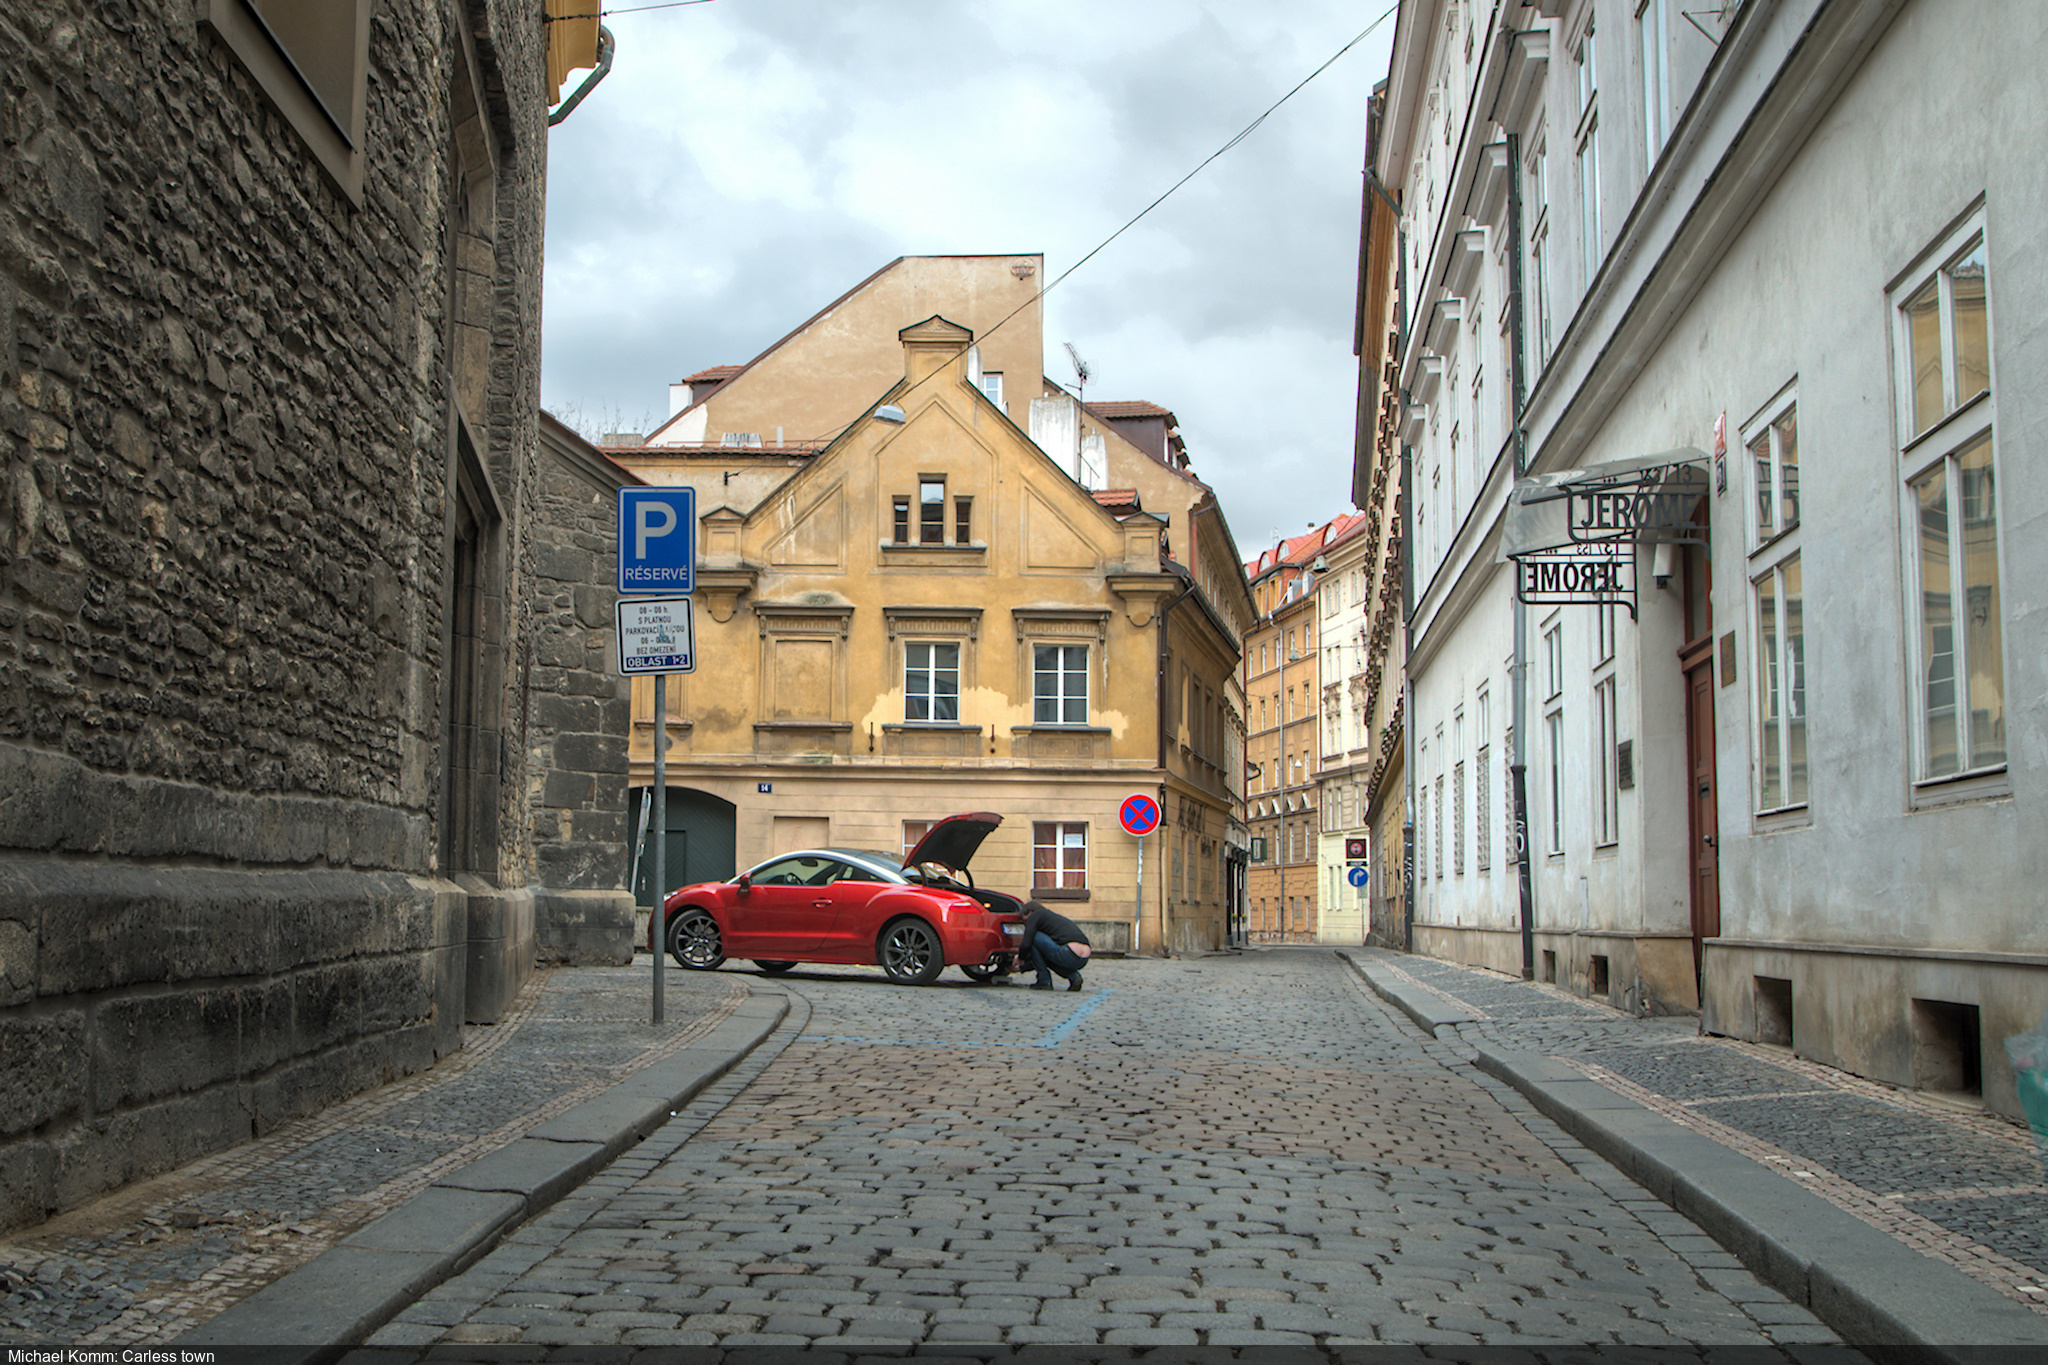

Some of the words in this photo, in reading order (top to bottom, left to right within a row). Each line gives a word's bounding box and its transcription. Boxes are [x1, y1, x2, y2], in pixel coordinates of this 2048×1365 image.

[1581, 494, 1696, 529] JEROME
[636, 501, 677, 559] P
[625, 565, 688, 580] RÉSERVÉ
[638, 616, 643, 625] S
[644, 615, 672, 624] PLATNOU
[636, 646, 648, 655] BEZ
[627, 655, 667, 667] OBLAST
